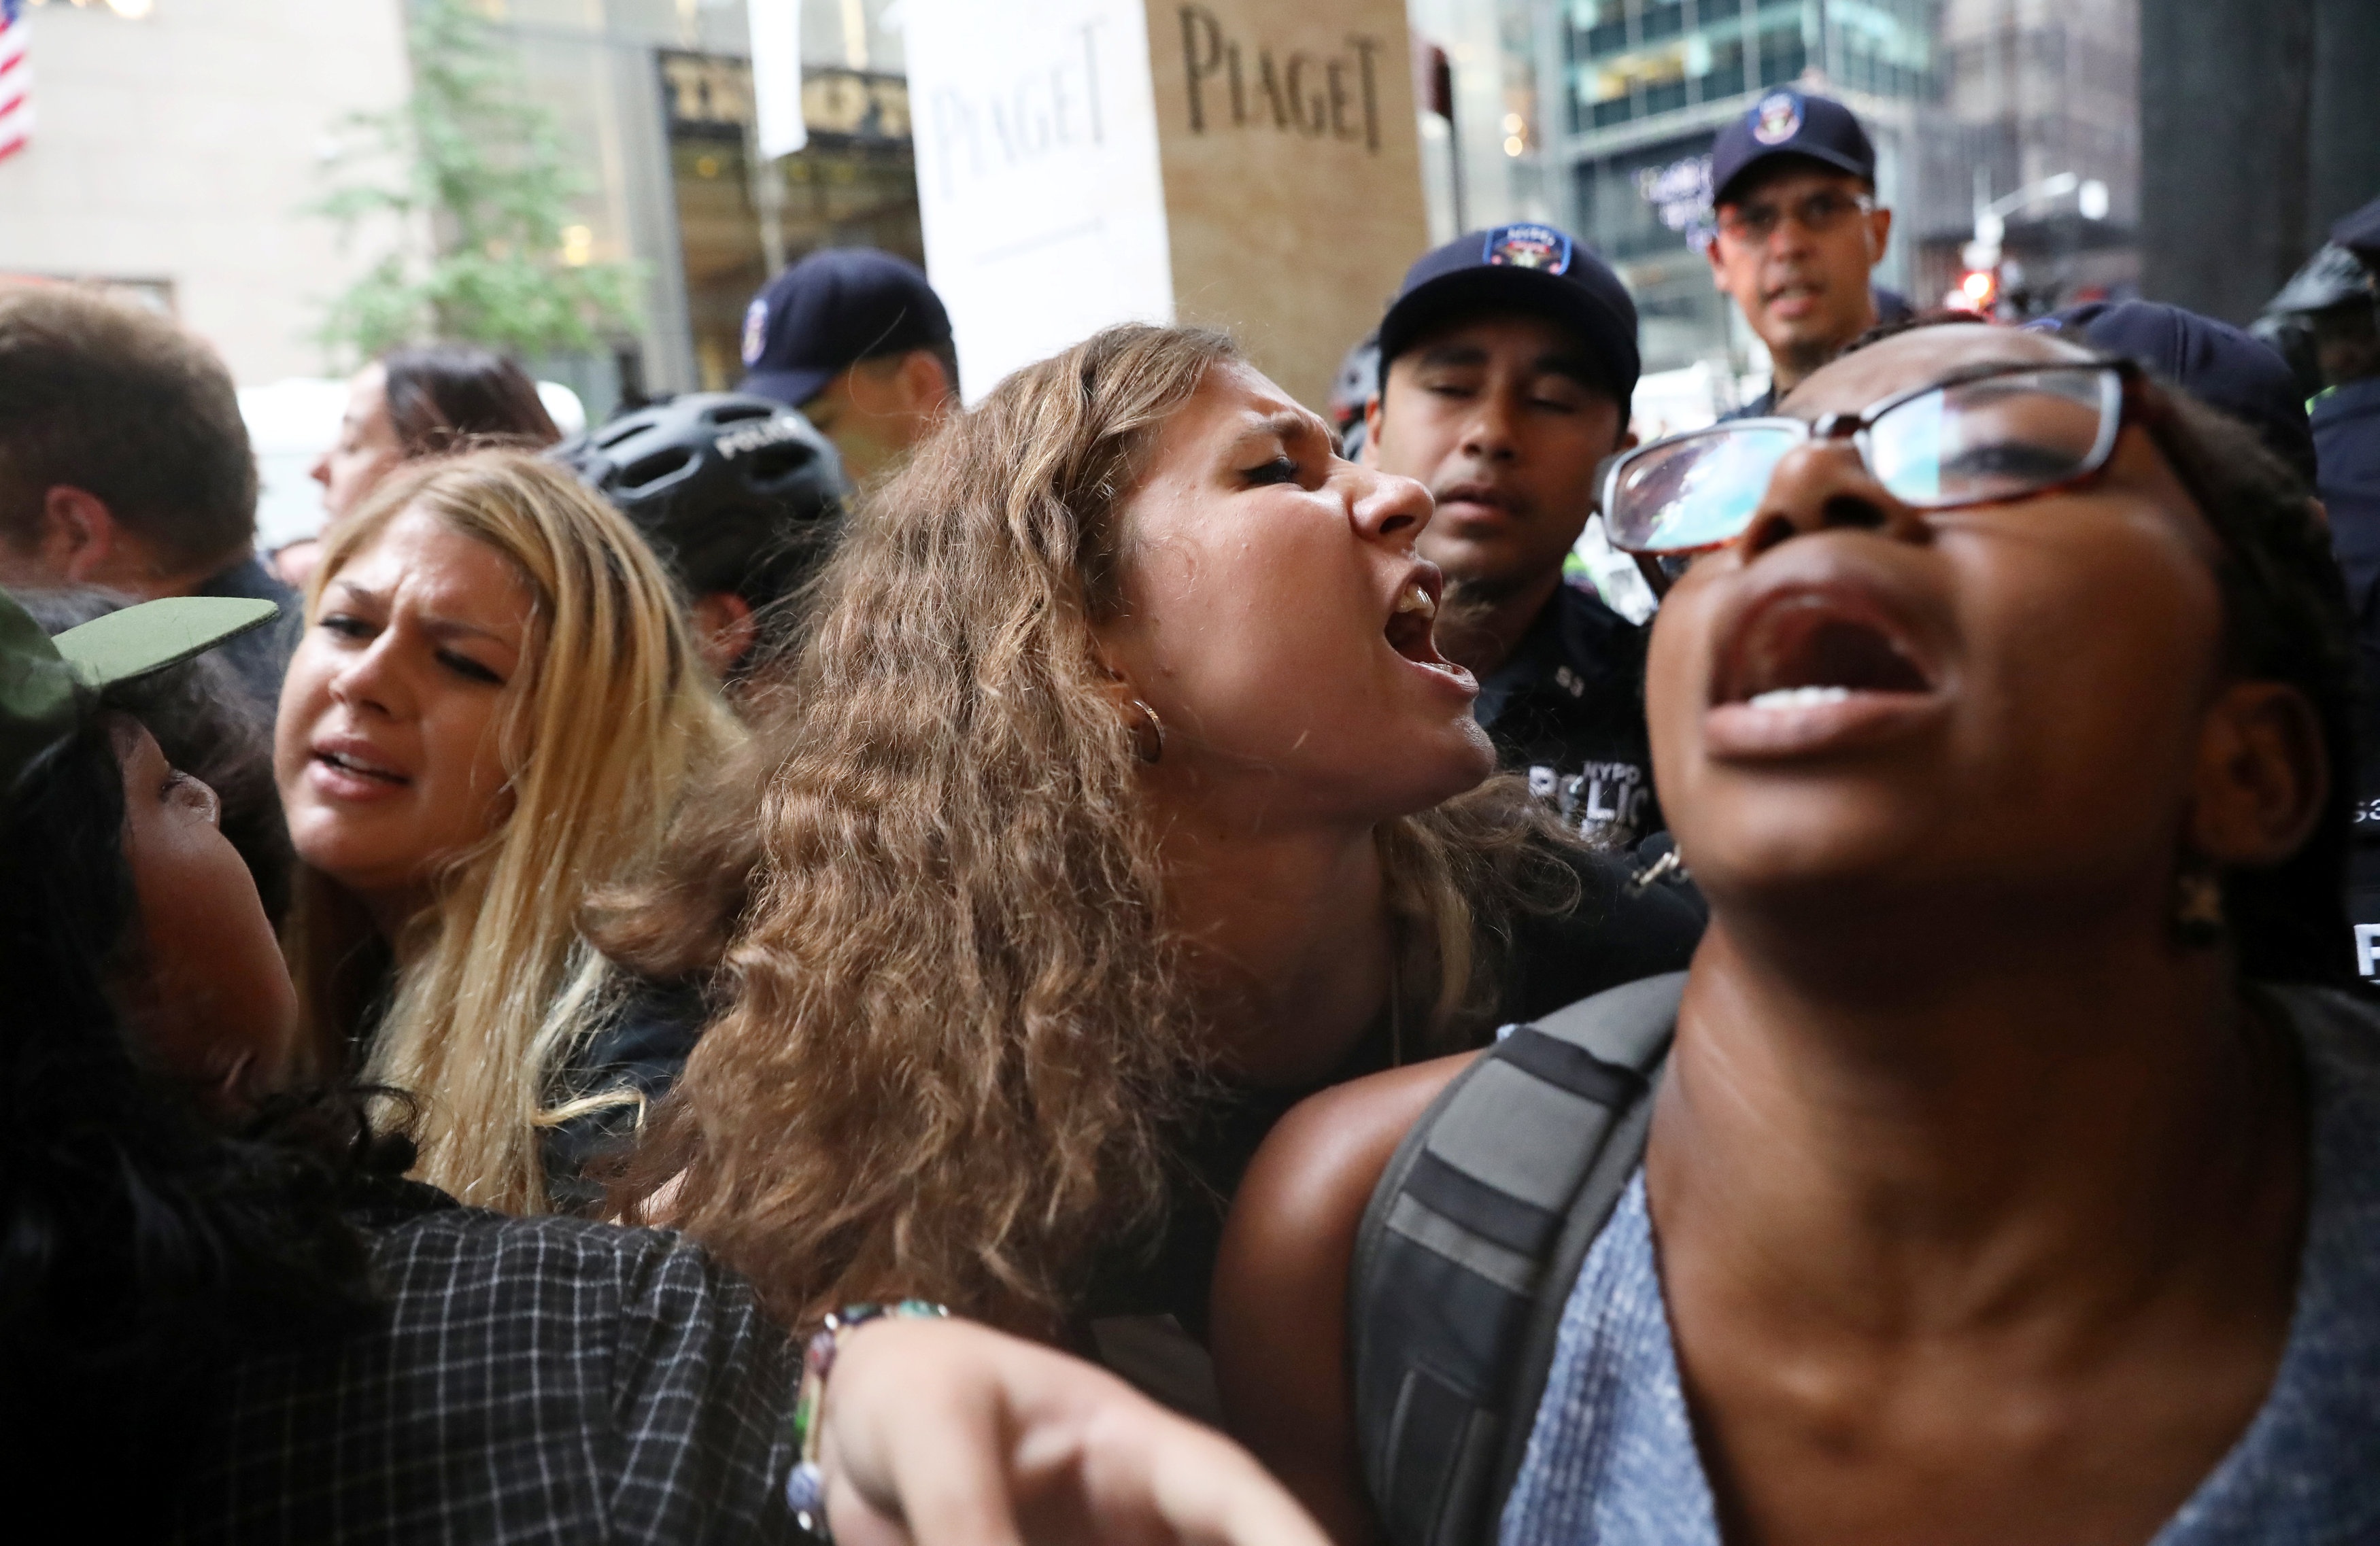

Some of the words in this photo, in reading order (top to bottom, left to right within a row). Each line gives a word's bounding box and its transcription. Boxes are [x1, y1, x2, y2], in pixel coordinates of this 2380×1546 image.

[931, 18, 1106, 201] PIAGET
[1180, 6, 1384, 155] PIAGET
[1583, 761, 1640, 785] NYPD
